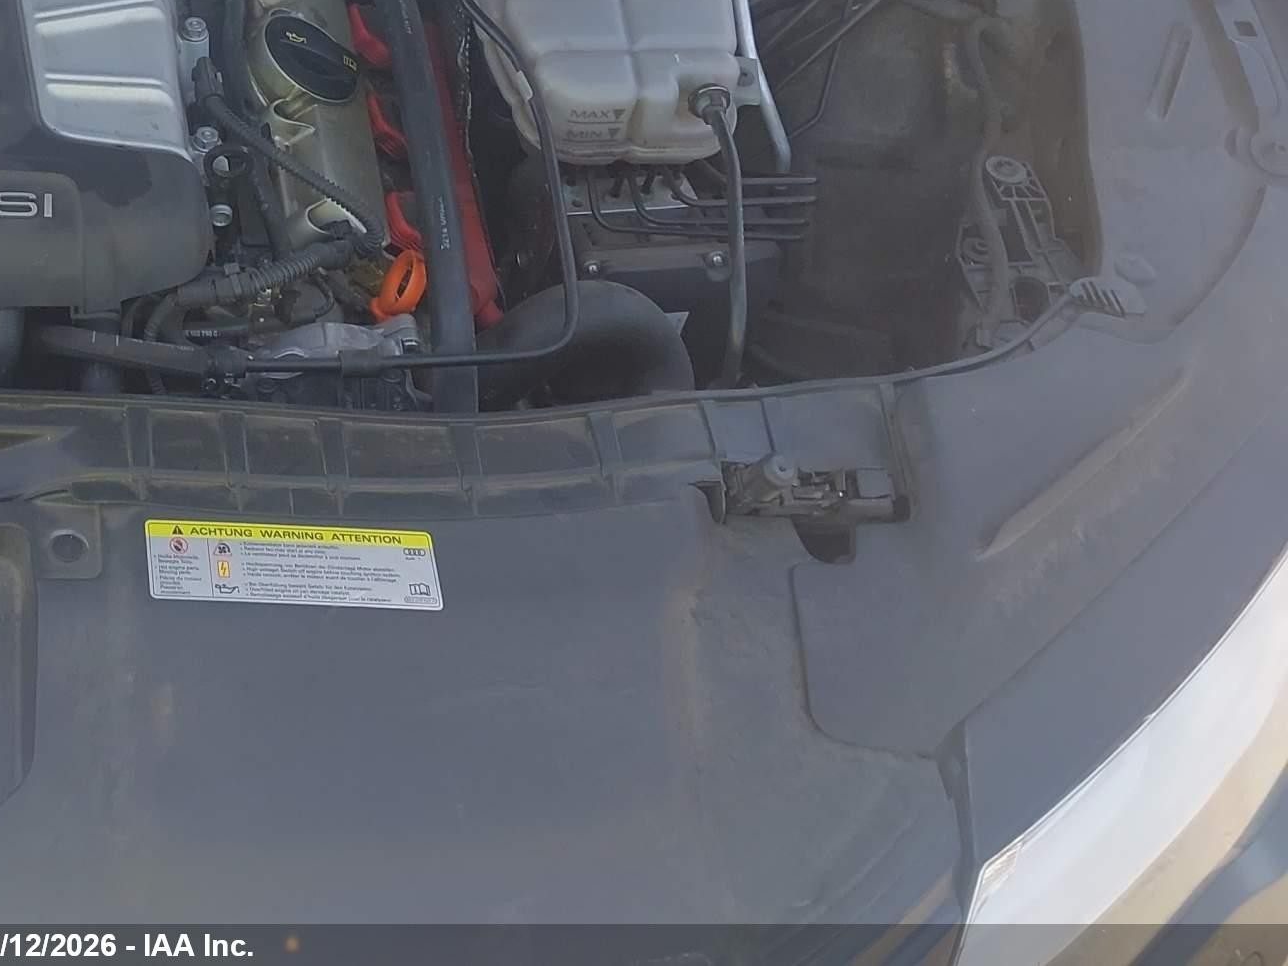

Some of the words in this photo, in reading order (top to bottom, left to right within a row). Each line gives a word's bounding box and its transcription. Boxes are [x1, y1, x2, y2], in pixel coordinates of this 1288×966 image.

[569, 108, 610, 120] MAX
[566, 129, 604, 139] MIN
[190, 526, 253, 538] ACHTUNG
[259, 529, 324, 541] WARNING
[331, 533, 402, 545] ATTENTION
